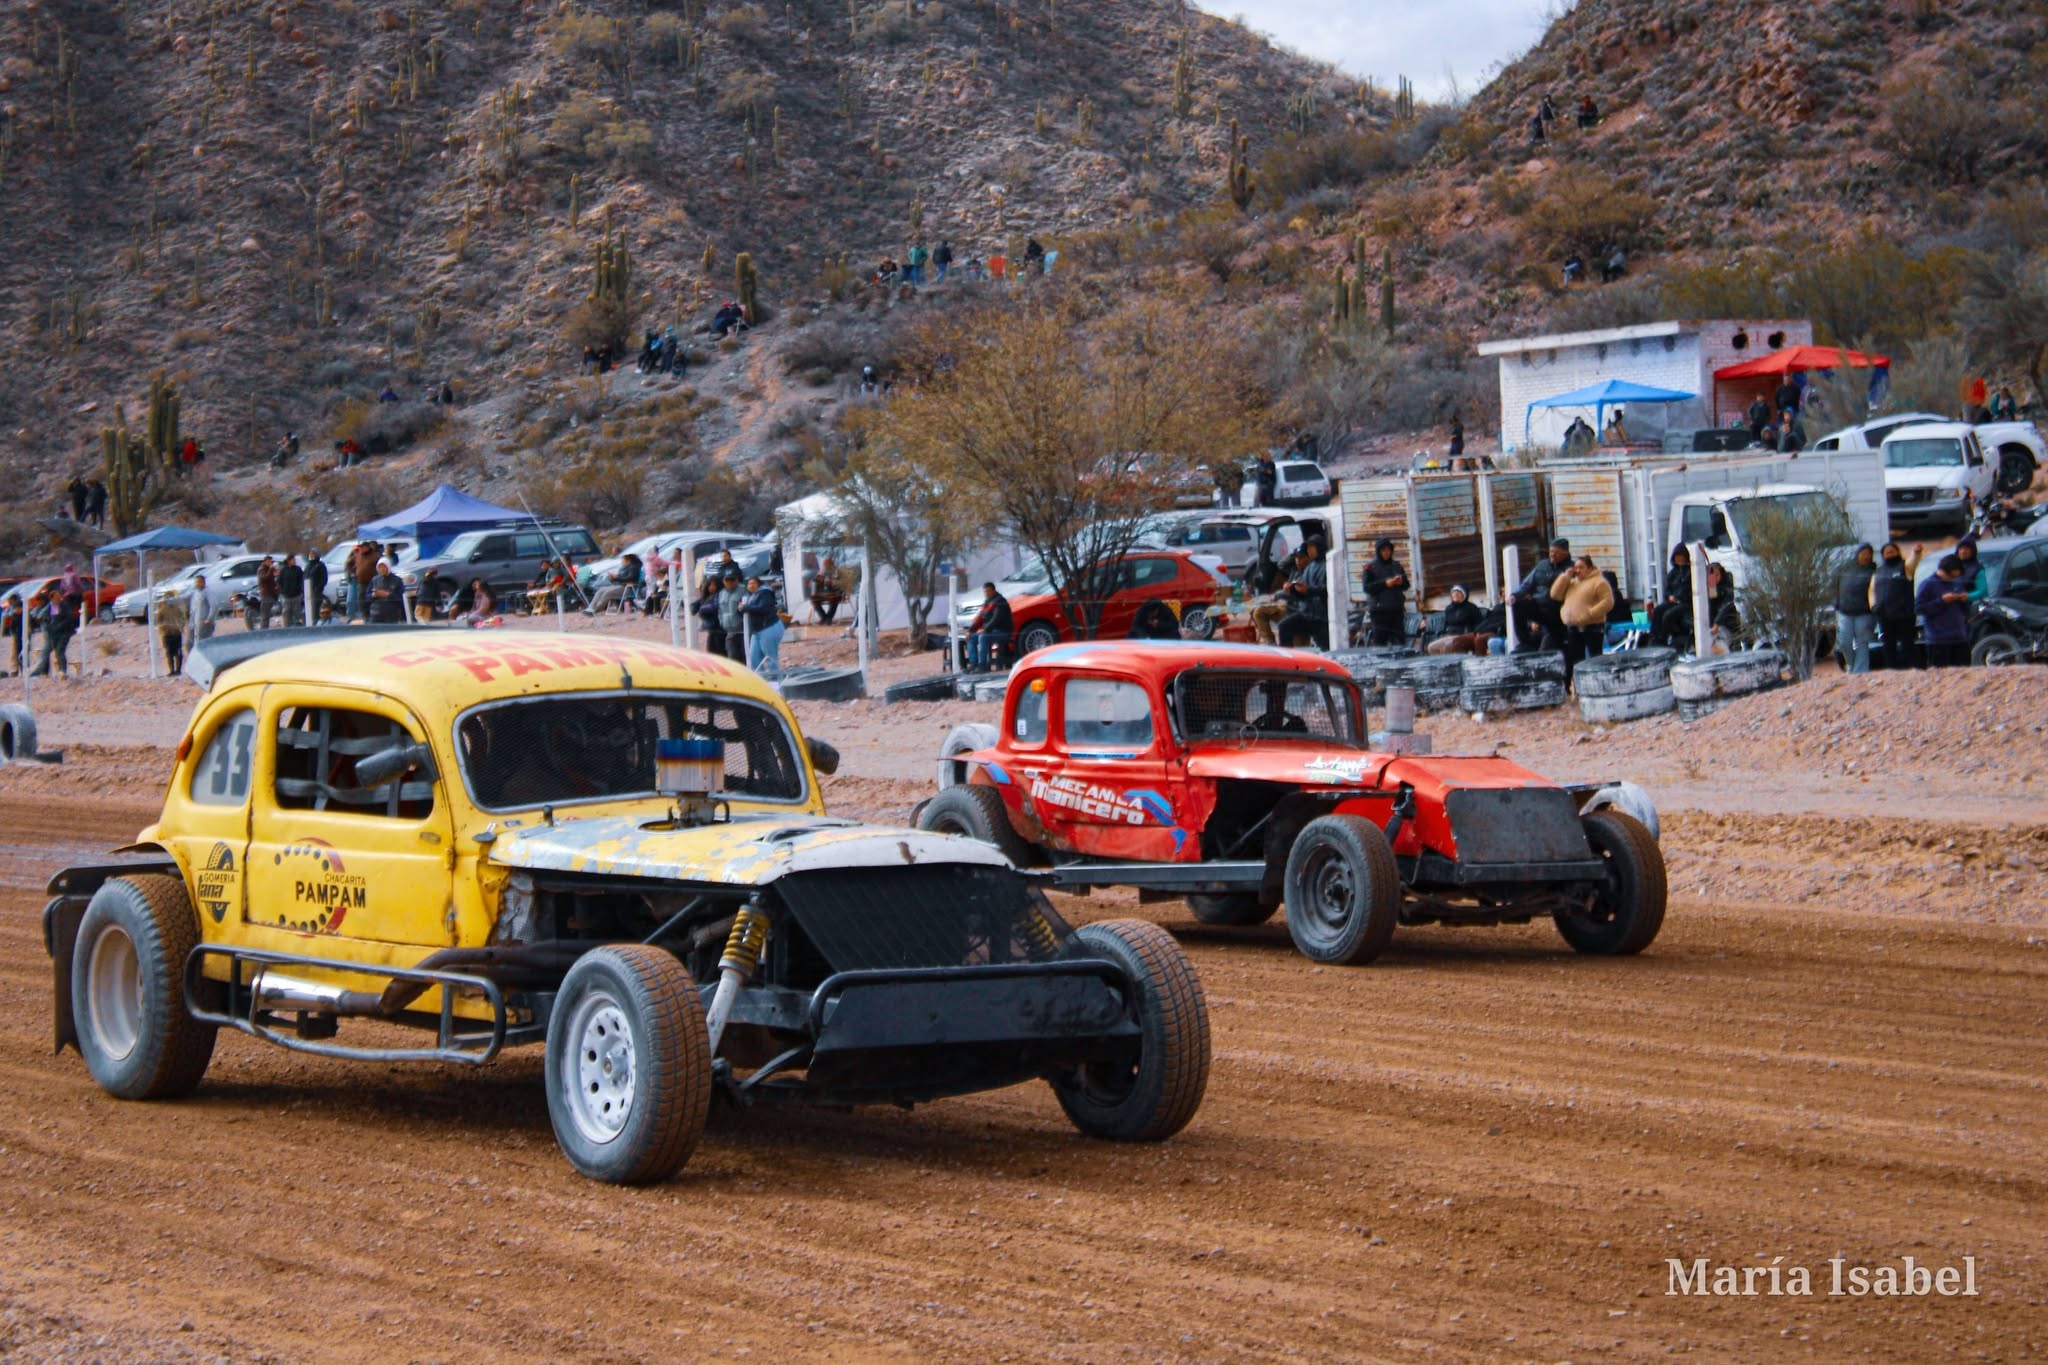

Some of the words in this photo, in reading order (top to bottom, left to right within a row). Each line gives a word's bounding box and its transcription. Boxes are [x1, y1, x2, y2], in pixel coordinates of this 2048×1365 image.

[456, 648, 733, 683] PAMPAM
[325, 873, 366, 886] CHACARITA
[295, 880, 366, 909] PAMPAM
